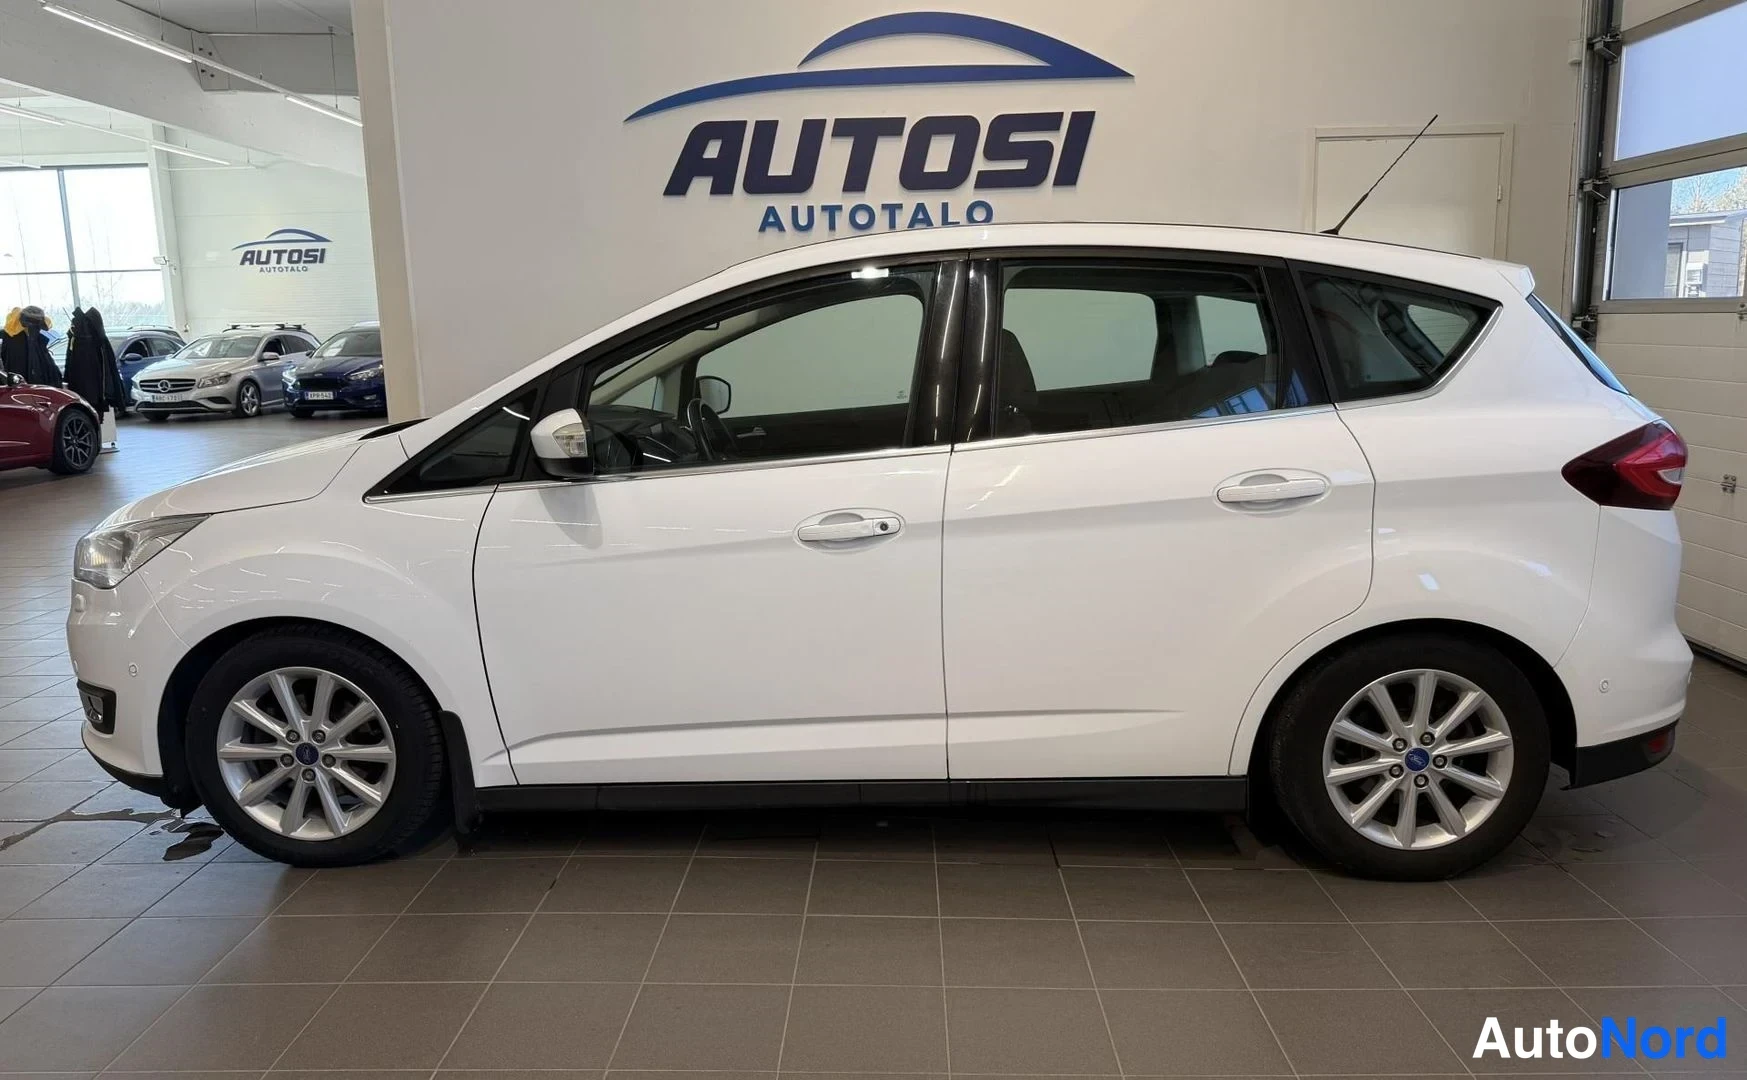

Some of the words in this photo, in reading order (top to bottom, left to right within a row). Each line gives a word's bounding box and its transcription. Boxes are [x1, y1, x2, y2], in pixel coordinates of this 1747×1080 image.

[663, 110, 1097, 197] AUTOSI
[758, 200, 994, 233] AUTOTALO
[239, 248, 326, 266] AUTOSI
